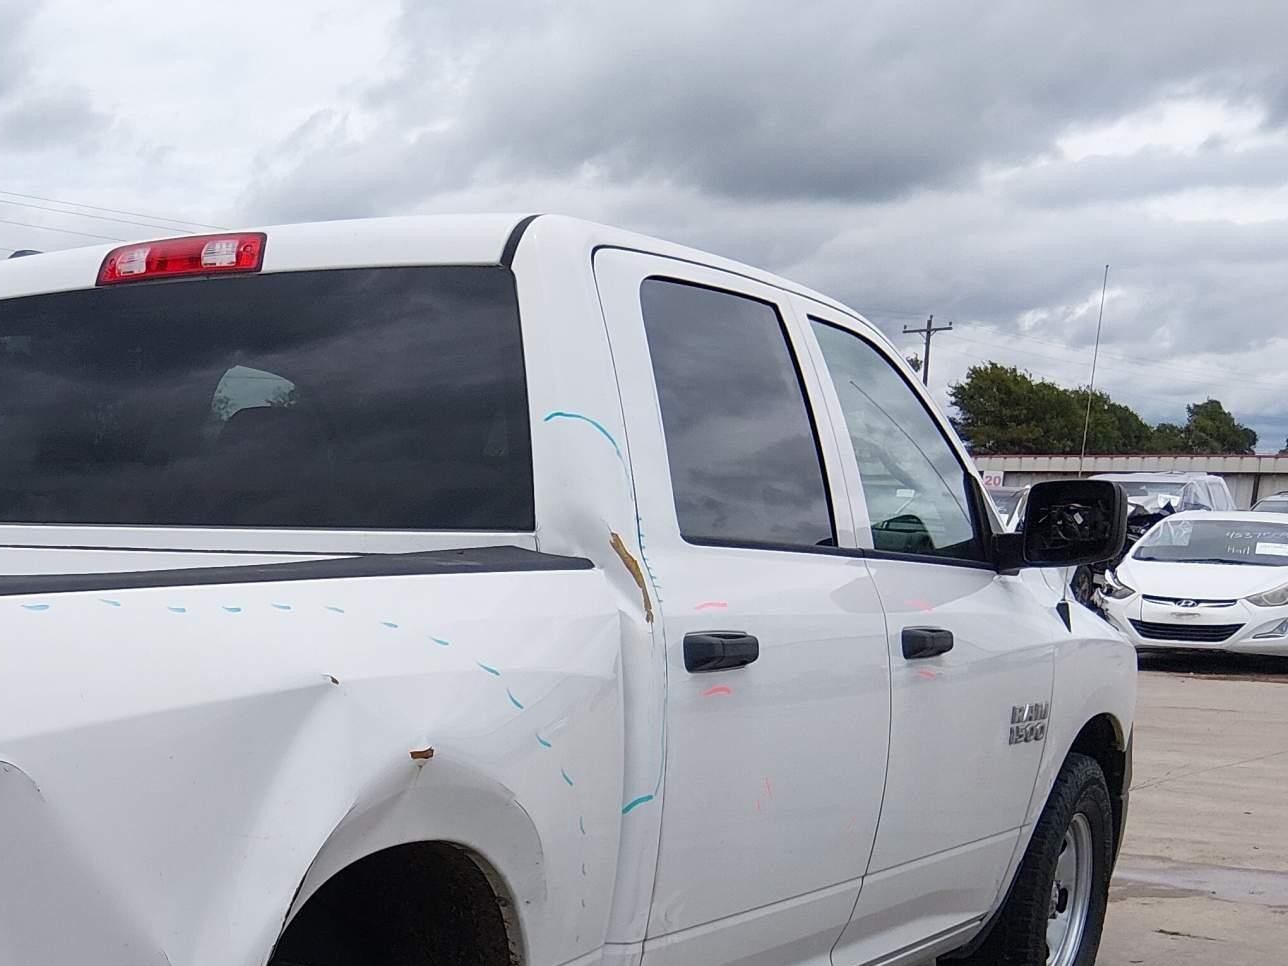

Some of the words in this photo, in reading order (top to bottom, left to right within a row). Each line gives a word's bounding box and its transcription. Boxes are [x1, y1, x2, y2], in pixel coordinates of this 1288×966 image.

[984, 475, 1002, 487] 20
[1011, 702, 1049, 724] RAM
[1008, 722, 1045, 745] 1500
